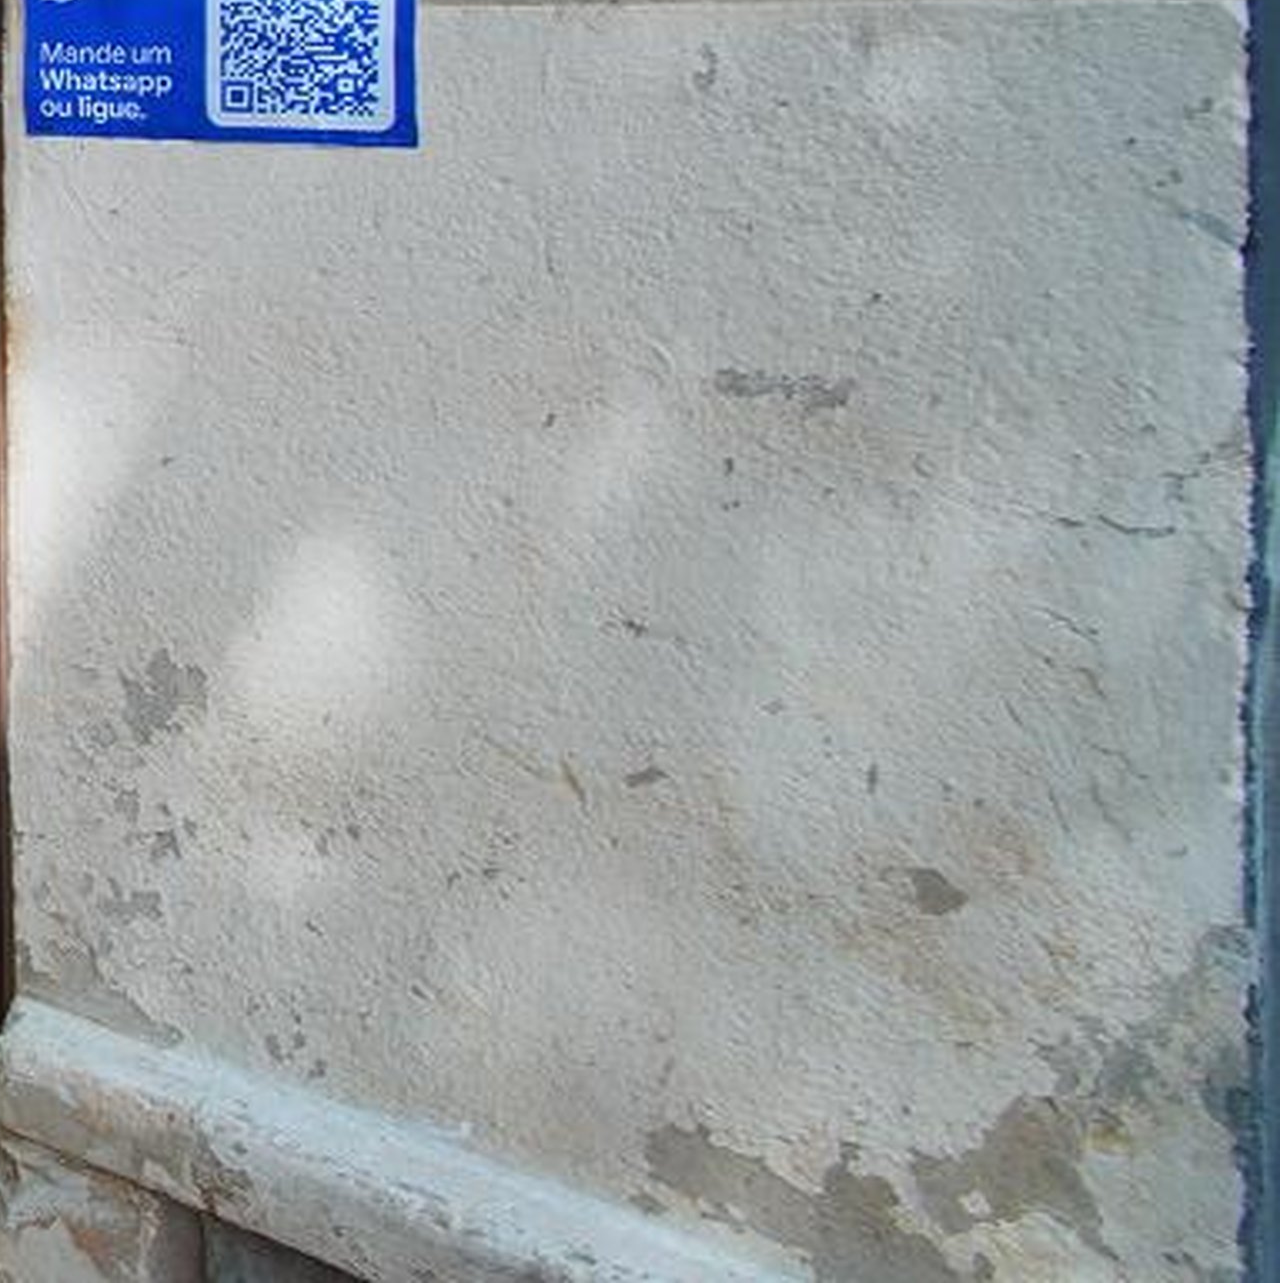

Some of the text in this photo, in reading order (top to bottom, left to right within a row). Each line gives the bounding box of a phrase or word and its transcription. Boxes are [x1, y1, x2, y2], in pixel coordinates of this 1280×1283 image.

[40, 41, 172, 65] Mande um
[40, 68, 173, 98] Whatsapp
[40, 99, 72, 117] ou
